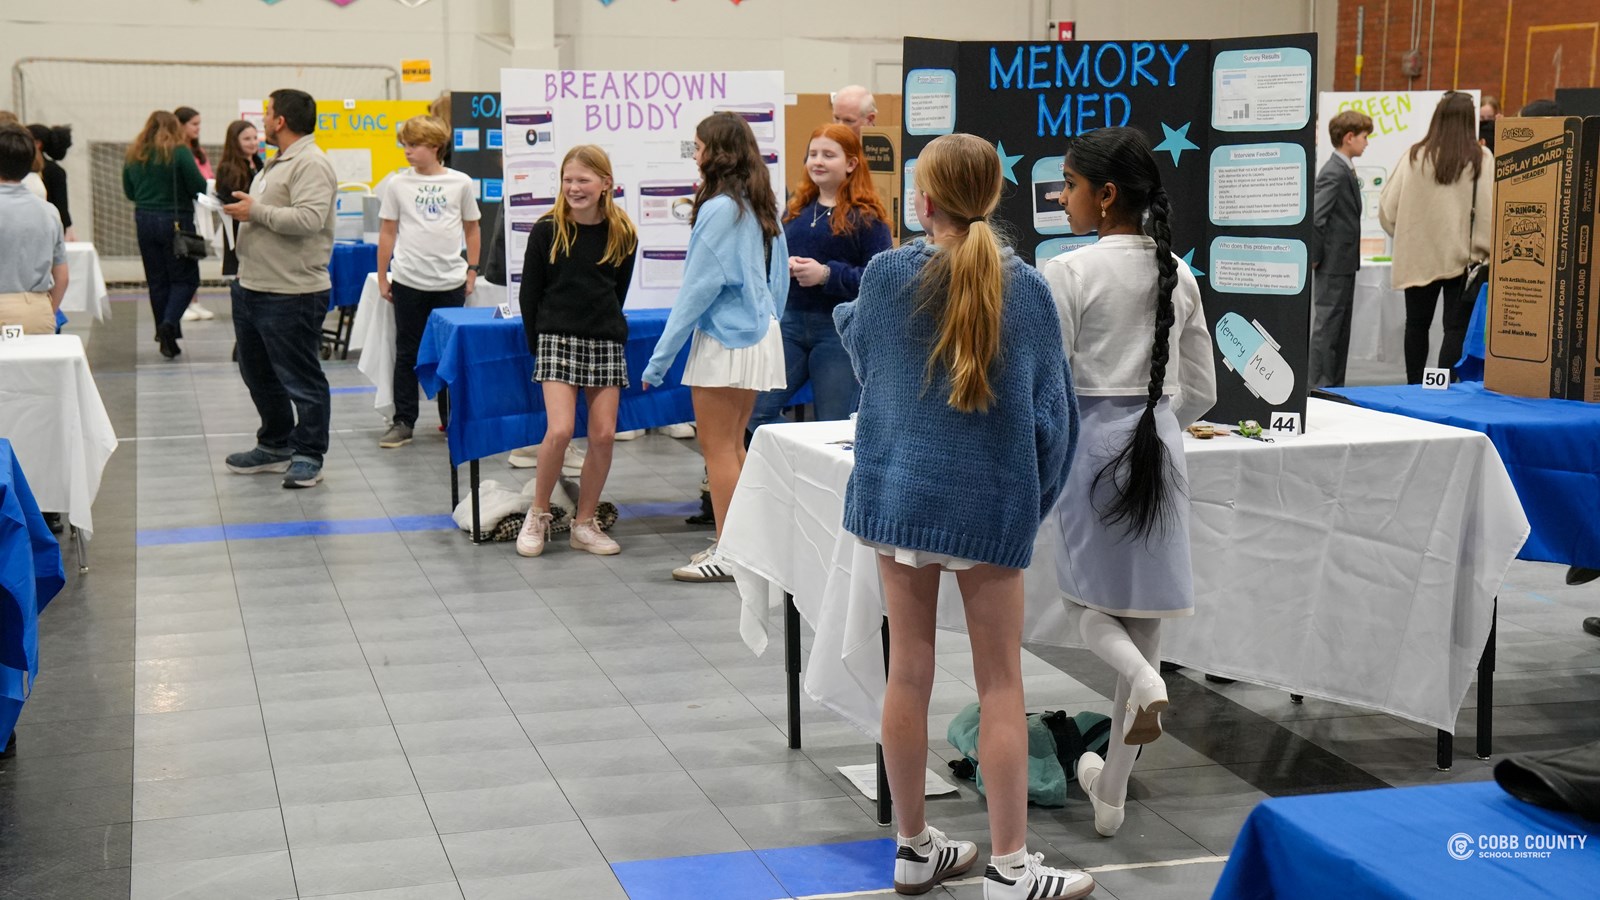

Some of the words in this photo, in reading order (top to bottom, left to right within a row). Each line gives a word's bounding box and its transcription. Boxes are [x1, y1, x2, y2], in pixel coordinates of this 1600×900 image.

[989, 41, 1190, 90] MEMORY
[545, 71, 726, 102] BREAKDOWN
[349, 114, 388, 130] VAC
[586, 102, 682, 132] BUDDY
[1036, 92, 1132, 137] MED
[1367, 113, 1408, 139] LL
[1502, 128, 1534, 142] ArtSkills
[1497, 158, 1530, 178] DISPLAY
[1532, 148, 1562, 166] BOARD
[1522, 168, 1545, 180] HEADER
[1565, 147, 1574, 184] HEADER
[1516, 205, 1536, 214] RINGS
[1561, 188, 1571, 249] ATTACHABLE
[1578, 269, 1586, 295] BOARD
[1576, 298, 1584, 329] DISPLAY
[6, 328, 20, 338] 57
[1217, 318, 1246, 357] Memory
[1250, 354, 1274, 380] Med
[1426, 372, 1446, 386] 50
[1273, 417, 1295, 432] 44
